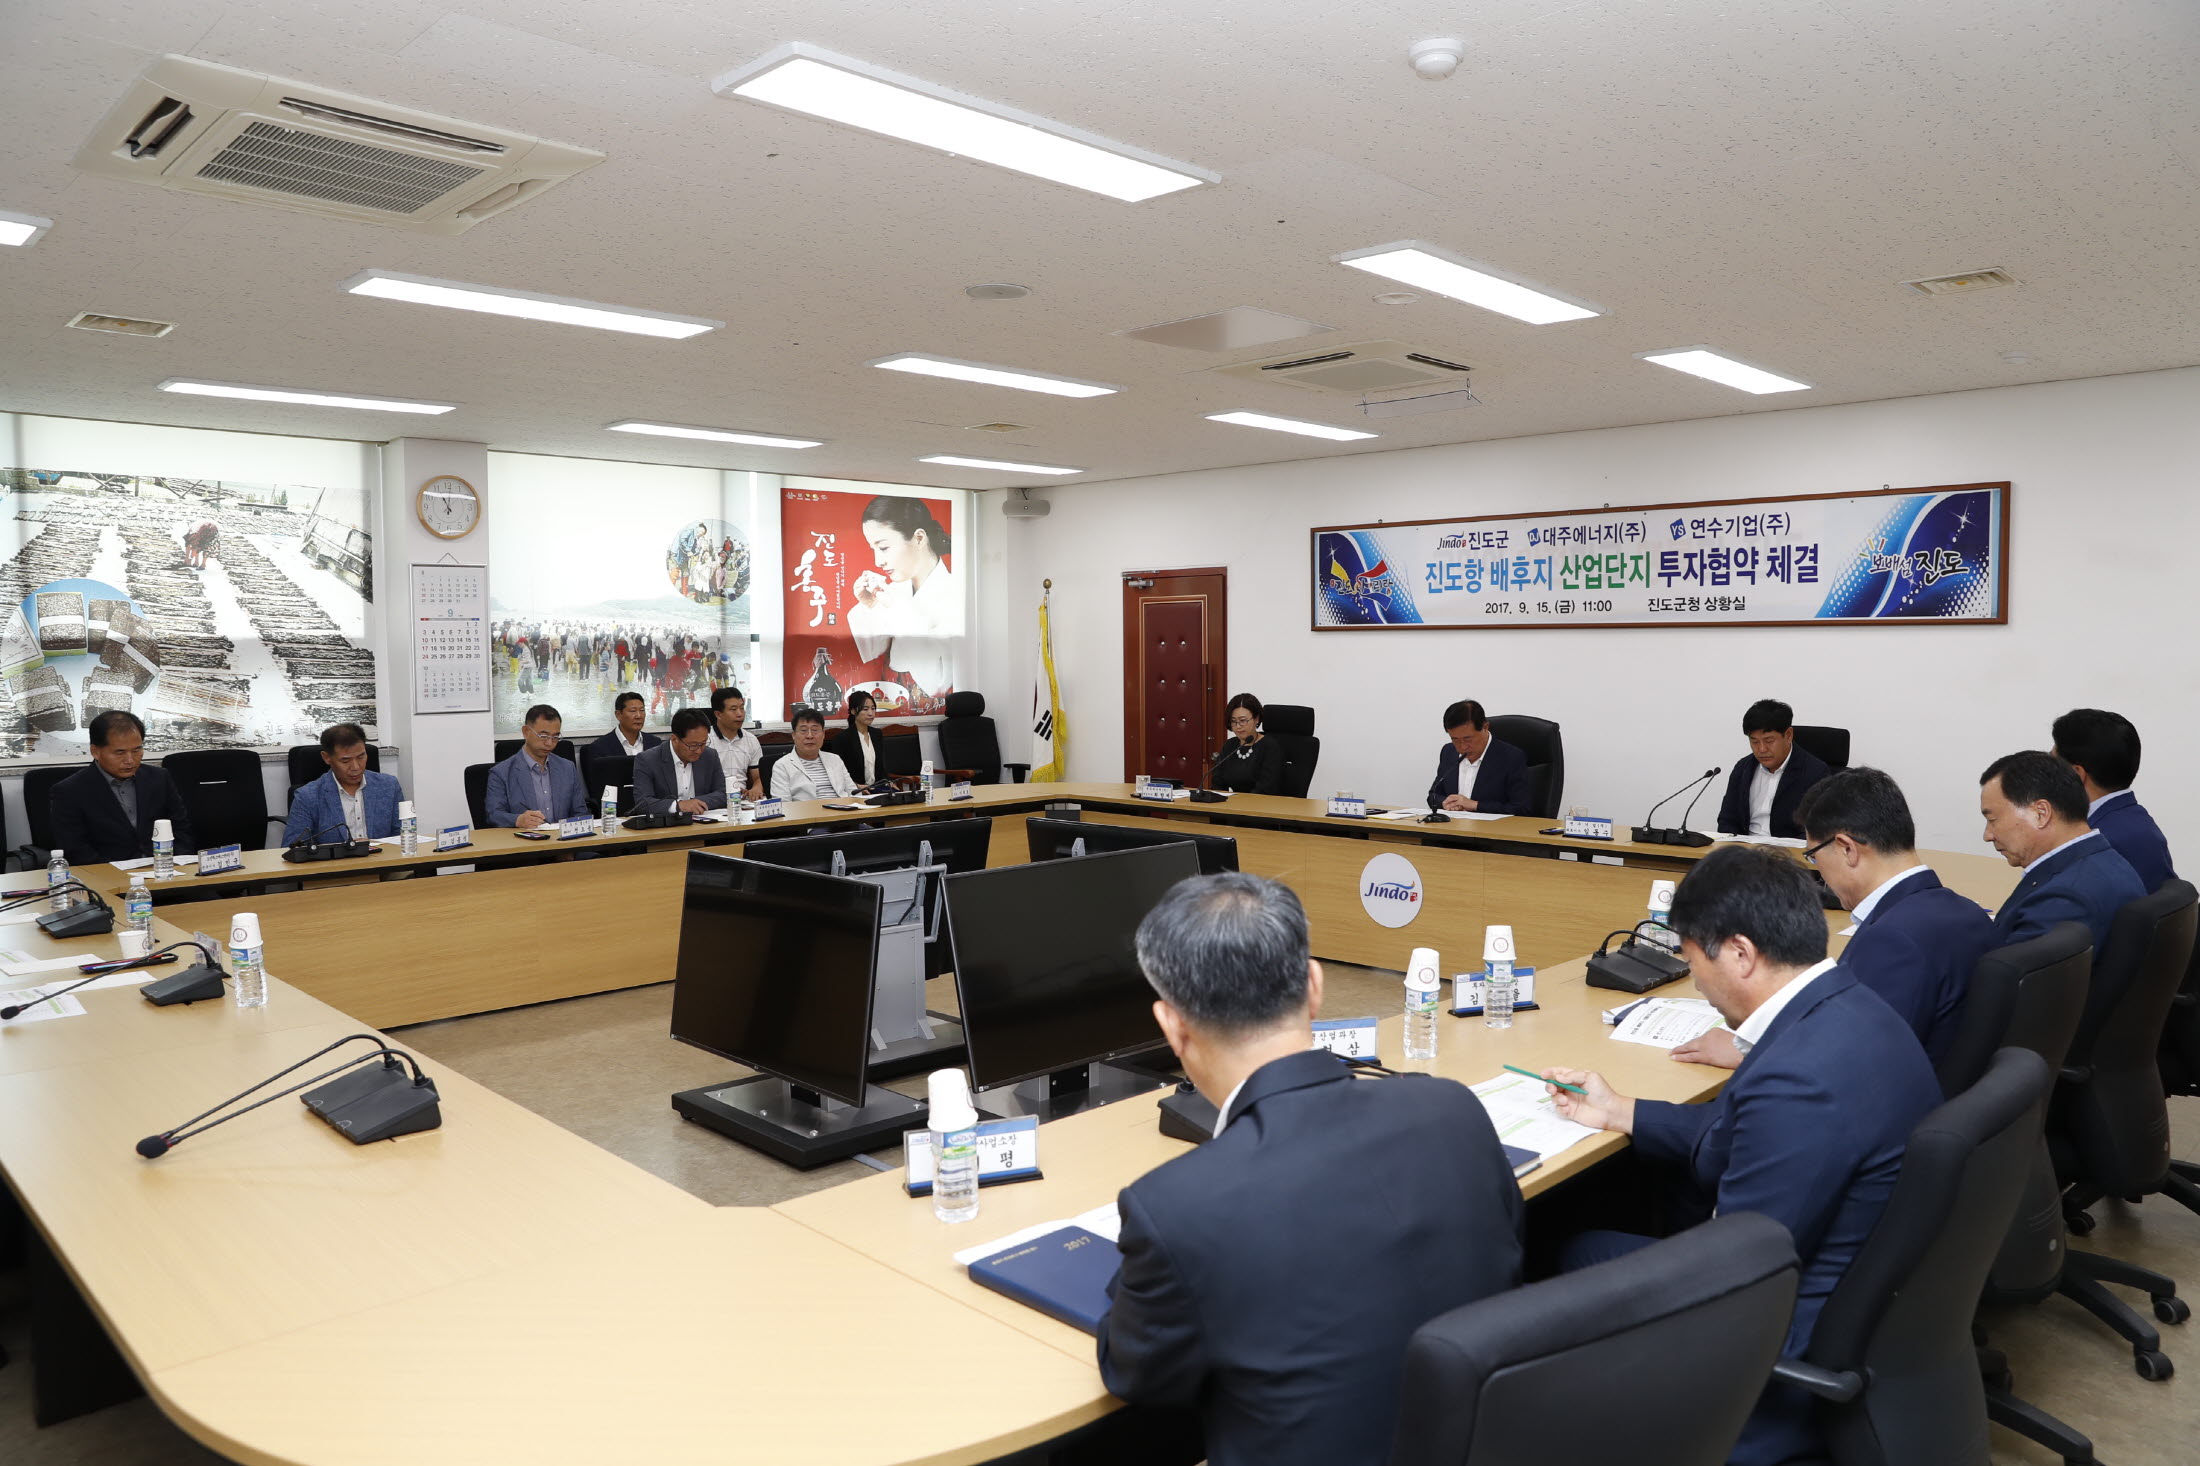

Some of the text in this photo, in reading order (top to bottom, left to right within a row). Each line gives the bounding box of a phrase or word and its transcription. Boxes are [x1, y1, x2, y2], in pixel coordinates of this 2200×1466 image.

[423, 503, 429, 511] 9
[1690, 511, 1791, 539] 연수기업(주)
[1468, 530, 1509, 550] 진도군
[1543, 521, 1647, 547] 대주에너지(주)
[810, 531, 839, 567] 진도
[1437, 537, 1462, 550] Jindo
[1425, 543, 1819, 594] 진도항 배후지 산업단지 투자협약 체결
[1914, 547, 1970, 586] 진도
[1485, 602, 1513, 614] 2017.
[1518, 602, 1529, 614] 9.
[1583, 600, 1613, 612] 11:00
[1647, 595, 1746, 612] 진도군청 상황실
[447, 609, 453, 617] 9
[1364, 882, 1409, 901] Jindo
[1347, 1042, 1360, 1056] 삼
[977, 1134, 1017, 1149] 사업소장
[1000, 1150, 1013, 1168] 평
[1064, 1236, 1091, 1251] 2017
